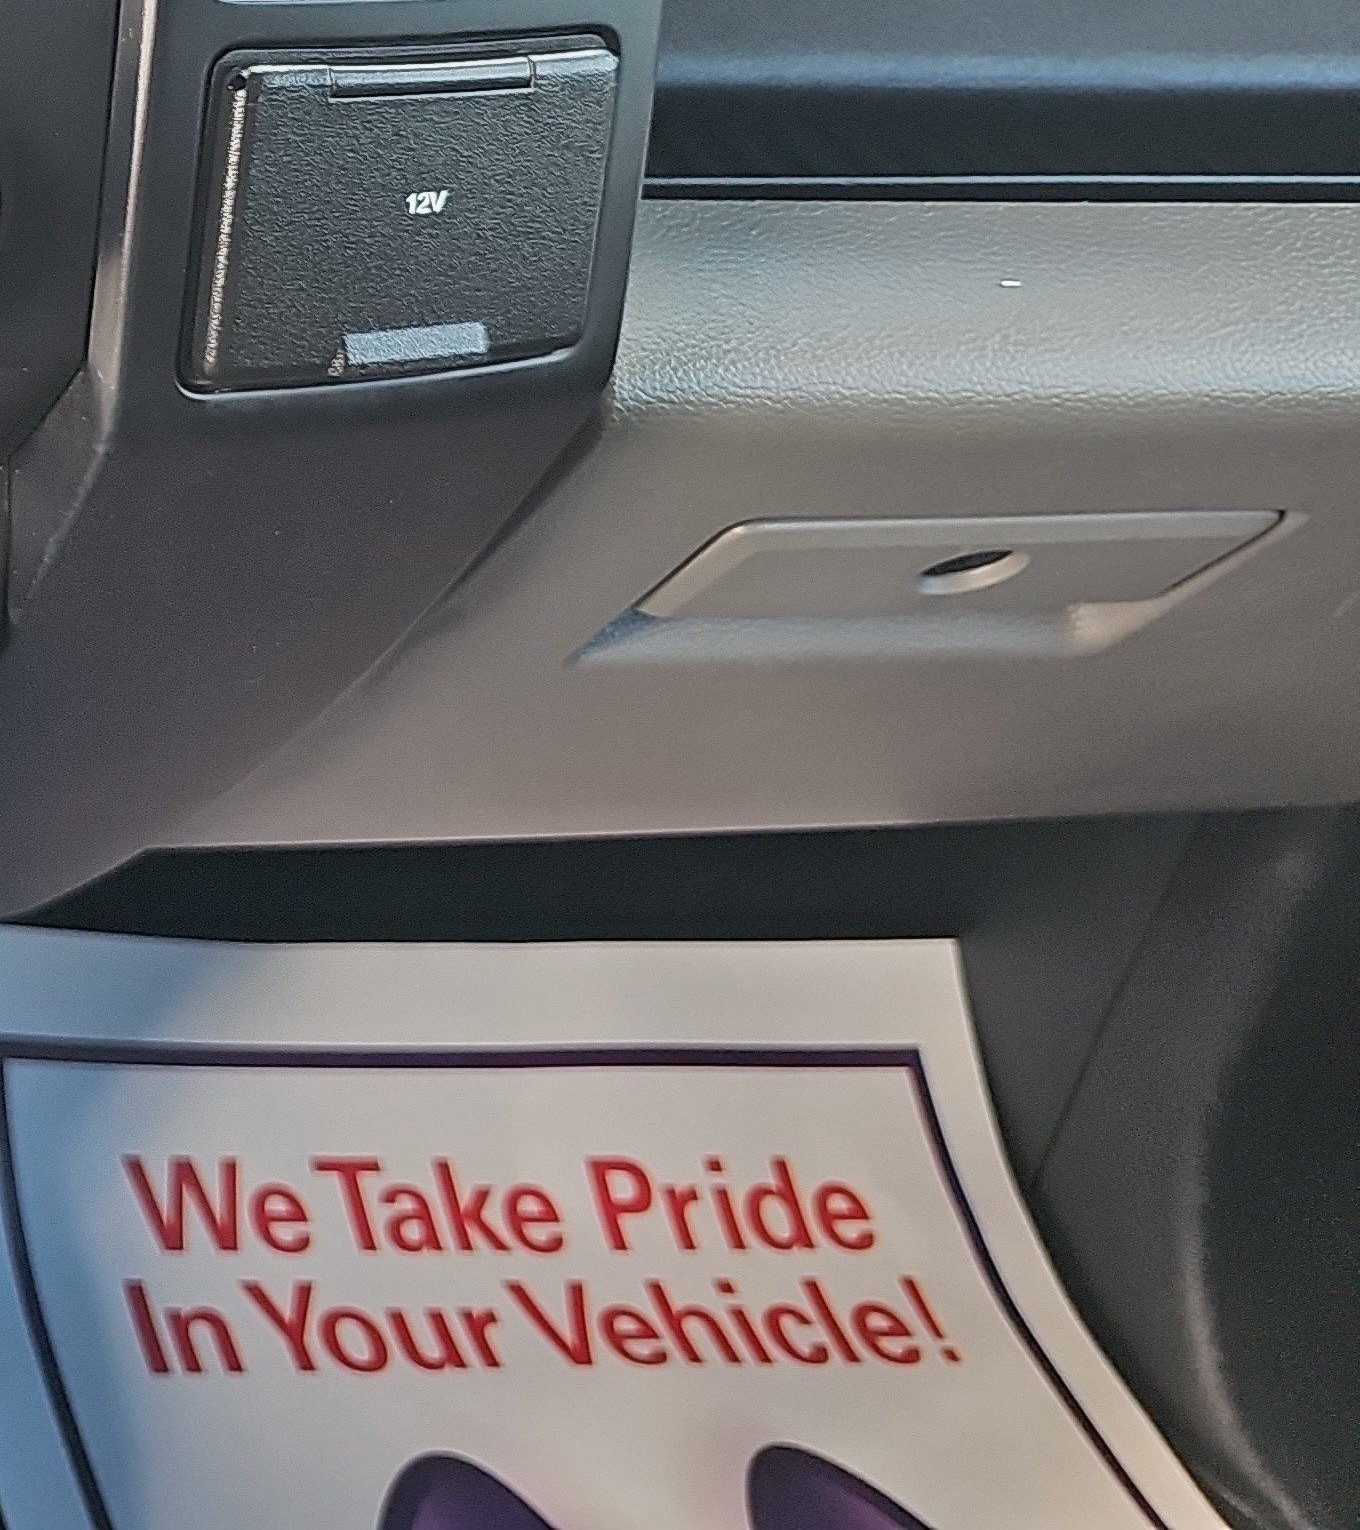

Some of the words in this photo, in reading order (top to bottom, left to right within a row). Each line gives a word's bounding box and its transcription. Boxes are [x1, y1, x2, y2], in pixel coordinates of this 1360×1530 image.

[405, 188, 450, 216] 12V
[122, 1152, 310, 1256] We
[310, 1154, 564, 1255] Take
[585, 1154, 878, 1255] Pride
[123, 1277, 246, 1376] In
[240, 1277, 509, 1375] Your
[506, 1274, 965, 1367] Vehicle!
